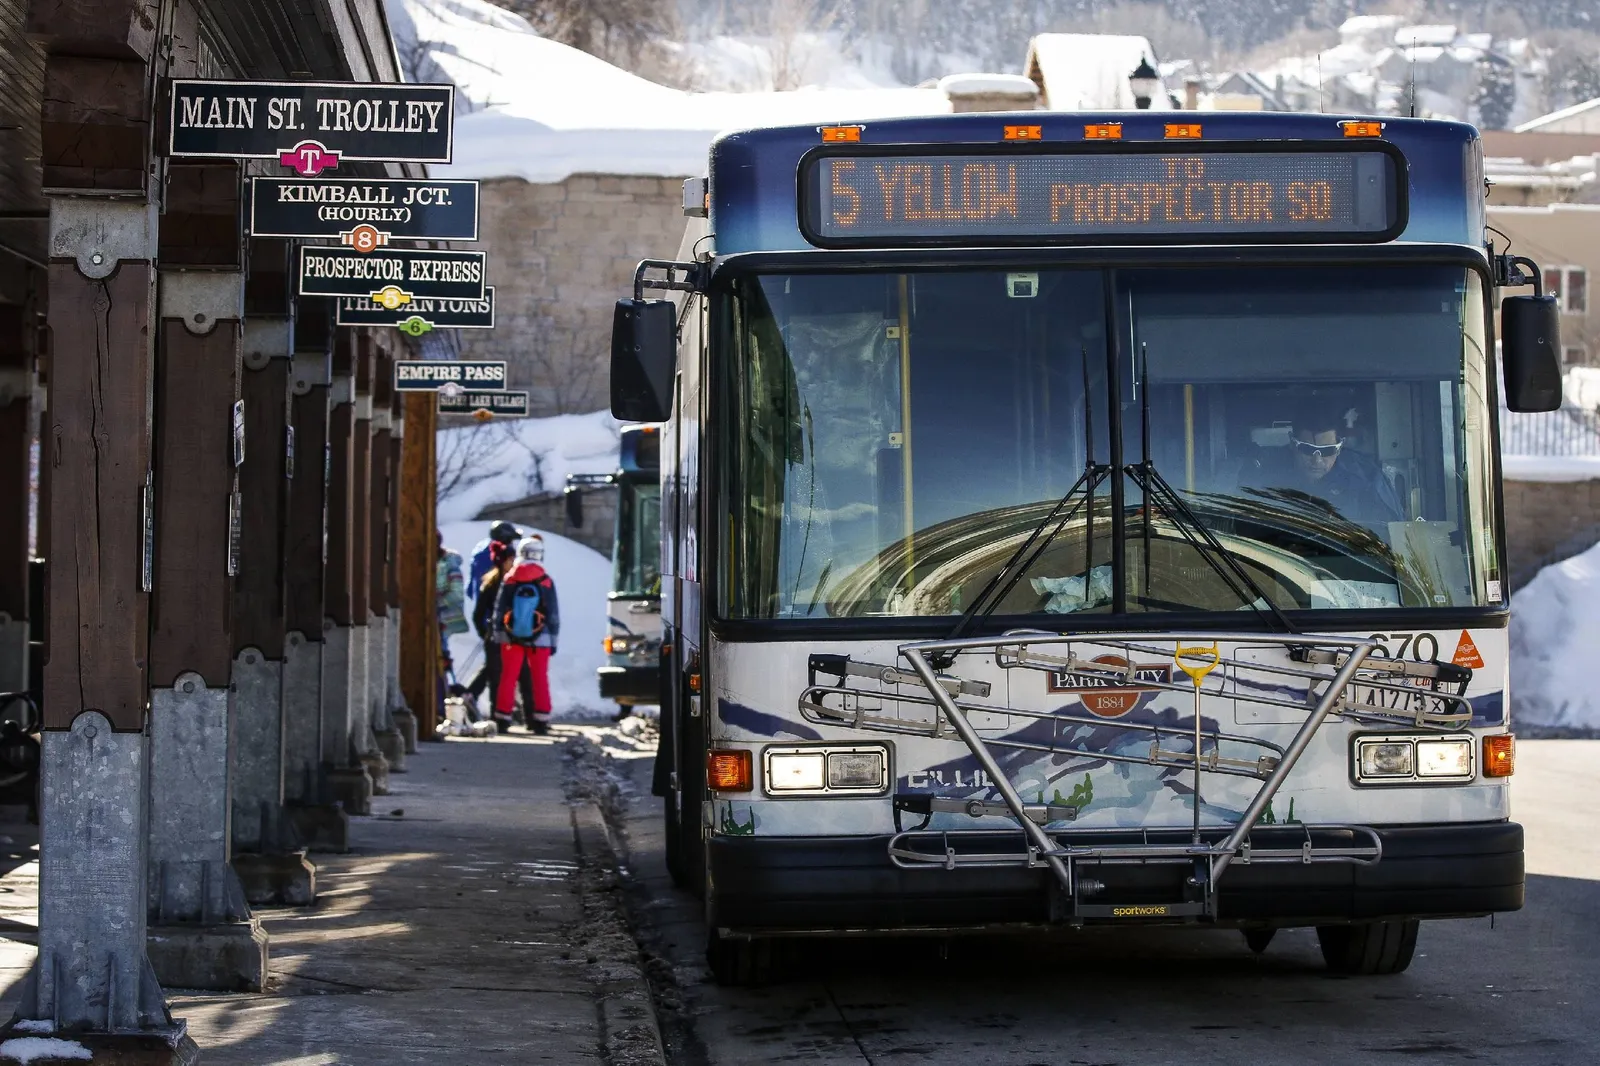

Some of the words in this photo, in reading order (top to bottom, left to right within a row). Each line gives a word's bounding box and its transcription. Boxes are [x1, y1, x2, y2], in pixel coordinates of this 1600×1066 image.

[179, 96, 257, 128] MAIN
[267, 97, 305, 130] ST.
[316, 99, 444, 133] TROLLEY
[300, 149, 320, 174] T
[1160, 157, 1204, 178] TO
[277, 185, 395, 204] KIMBALL
[402, 187, 453, 206] JCT.
[832, 161, 860, 225] 5
[874, 163, 1018, 220] YELLOW
[1050, 182, 1273, 222] PROSPECTOR
[317, 205, 412, 223] (HOURLY)
[358, 231, 372, 248] 8
[304, 256, 404, 281] PROSPECTOR
[408, 259, 481, 283] EXPRESS
[343, 297, 384, 311] THE
[396, 296, 491, 313] ANYONS
[384, 290, 398, 307] 5
[410, 321, 421, 334] 6
[398, 366, 461, 380] EMPIRE
[464, 366, 504, 381] PASS
[469, 394, 491, 407] LAKE
[492, 395, 525, 407] VILLAGE
[1113, 669, 1165, 687] CTY
[1096, 697, 1125, 709] 1884
[1113, 906, 1167, 916] sportworks
